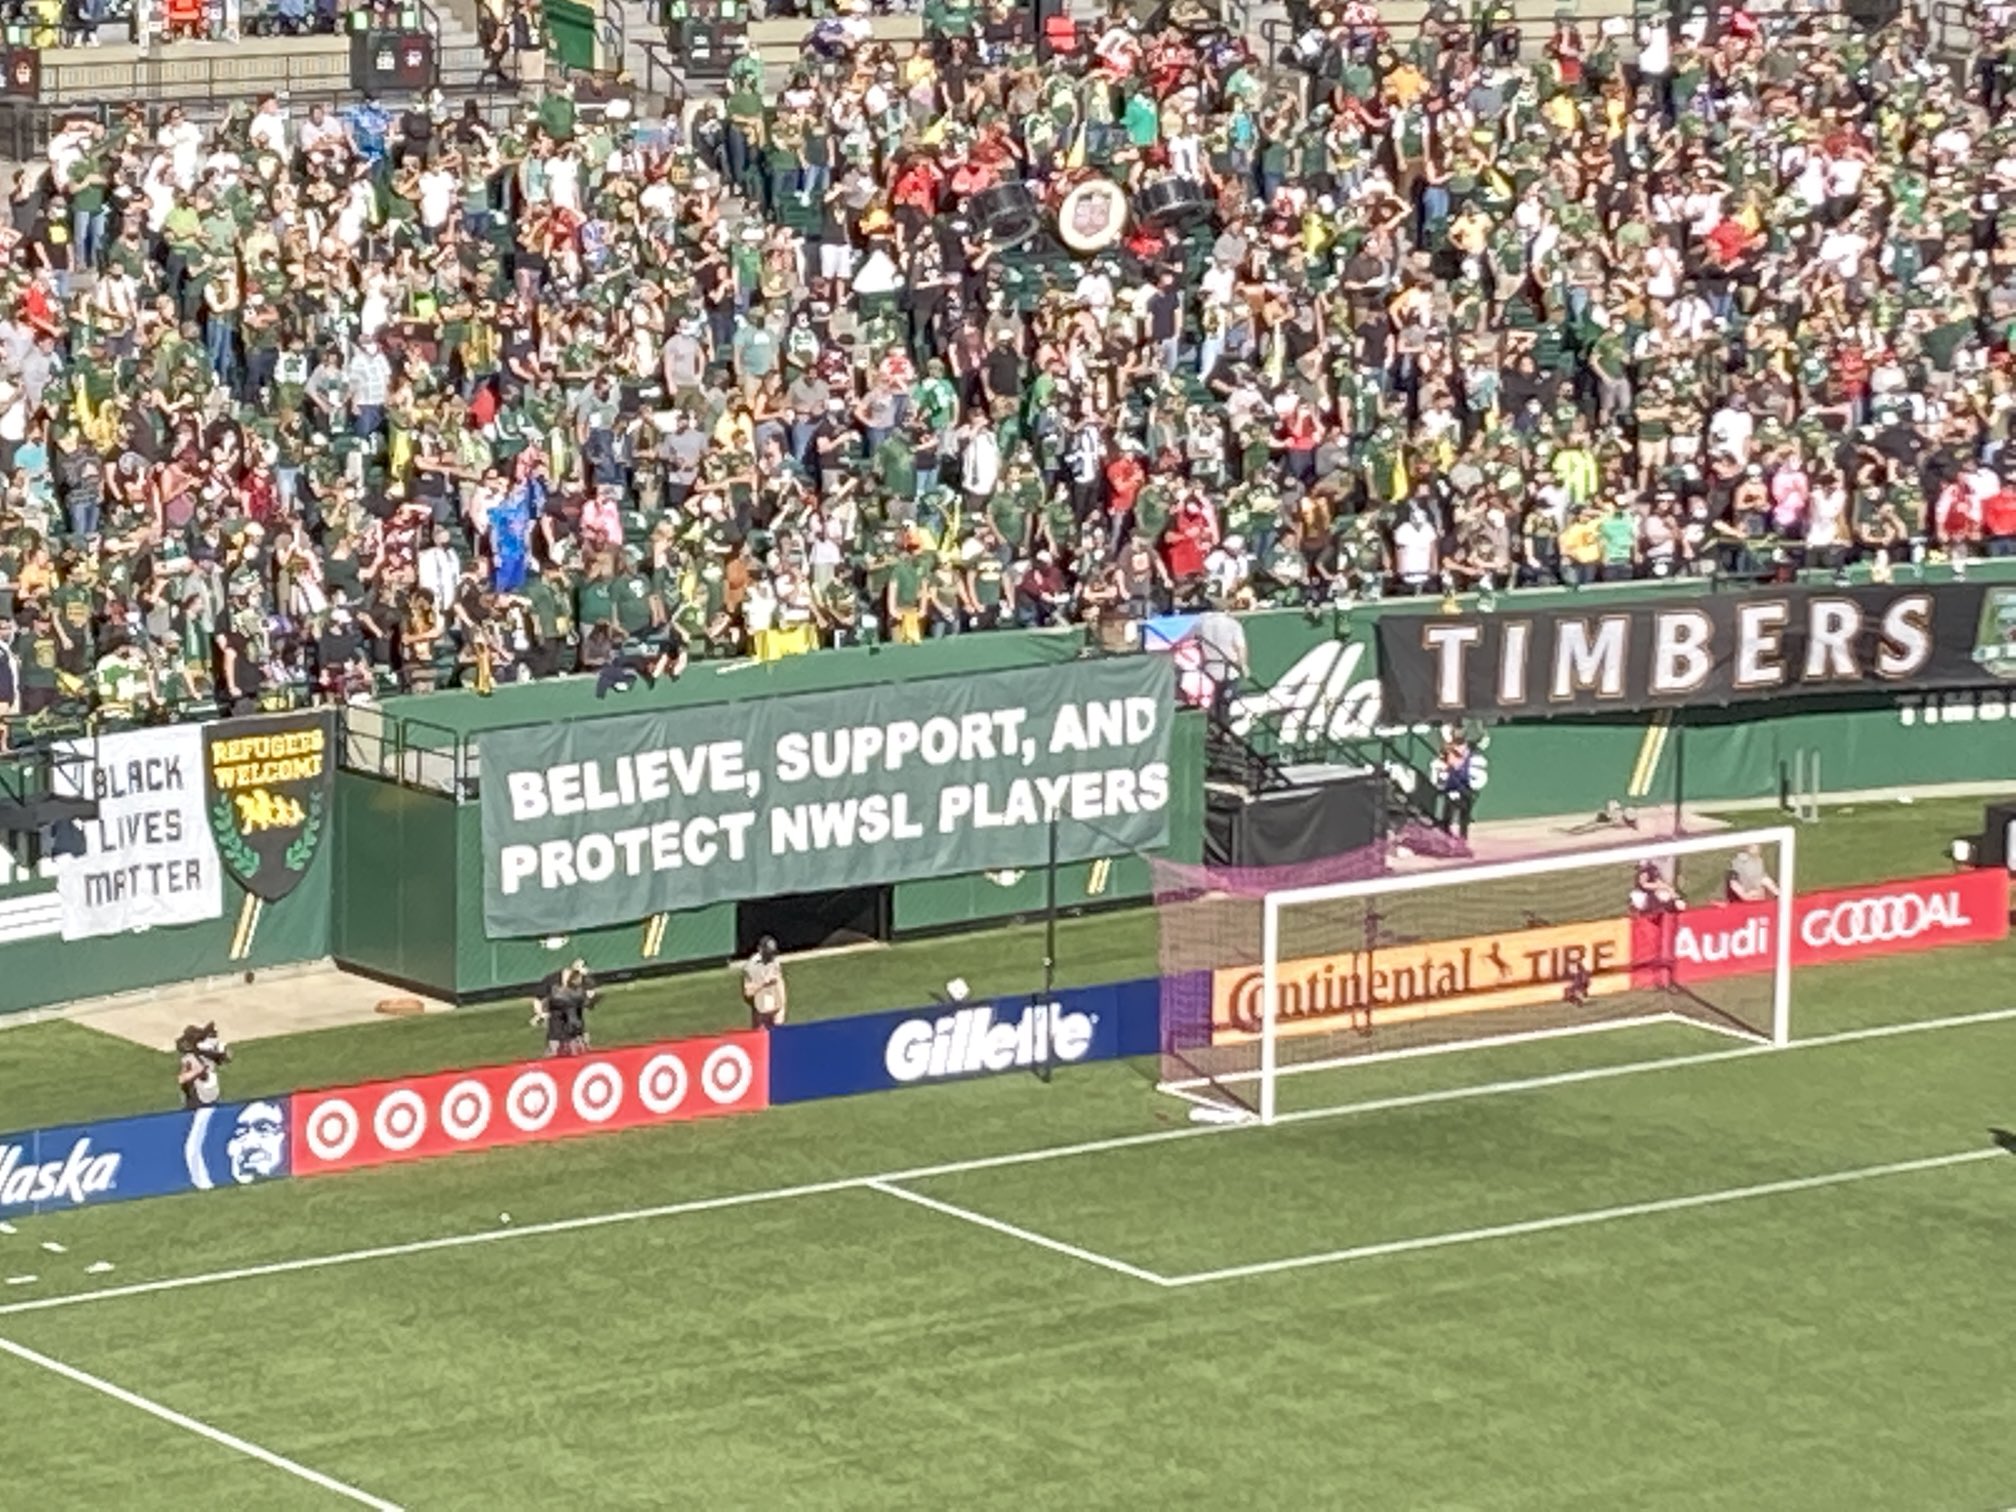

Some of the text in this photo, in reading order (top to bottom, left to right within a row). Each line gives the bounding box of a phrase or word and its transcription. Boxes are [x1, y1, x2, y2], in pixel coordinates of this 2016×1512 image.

[1423, 592, 1935, 711] TIMBERS
[211, 728, 324, 765] REFUGEES
[507, 696, 1157, 822] BELIEVE, SUPPORT, AND
[92, 754, 184, 800] BLACK
[213, 754, 323, 789] WELCOME
[99, 808, 182, 852] LIVES
[500, 762, 1170, 894] PROTECT NWSL PLAYERS
[84, 858, 202, 908] MATTER
[1522, 939, 1616, 982] TIRE
[1675, 917, 1772, 963] Audi
[885, 1001, 1093, 1082] Gillette
[0, 1136, 121, 1207] laska
